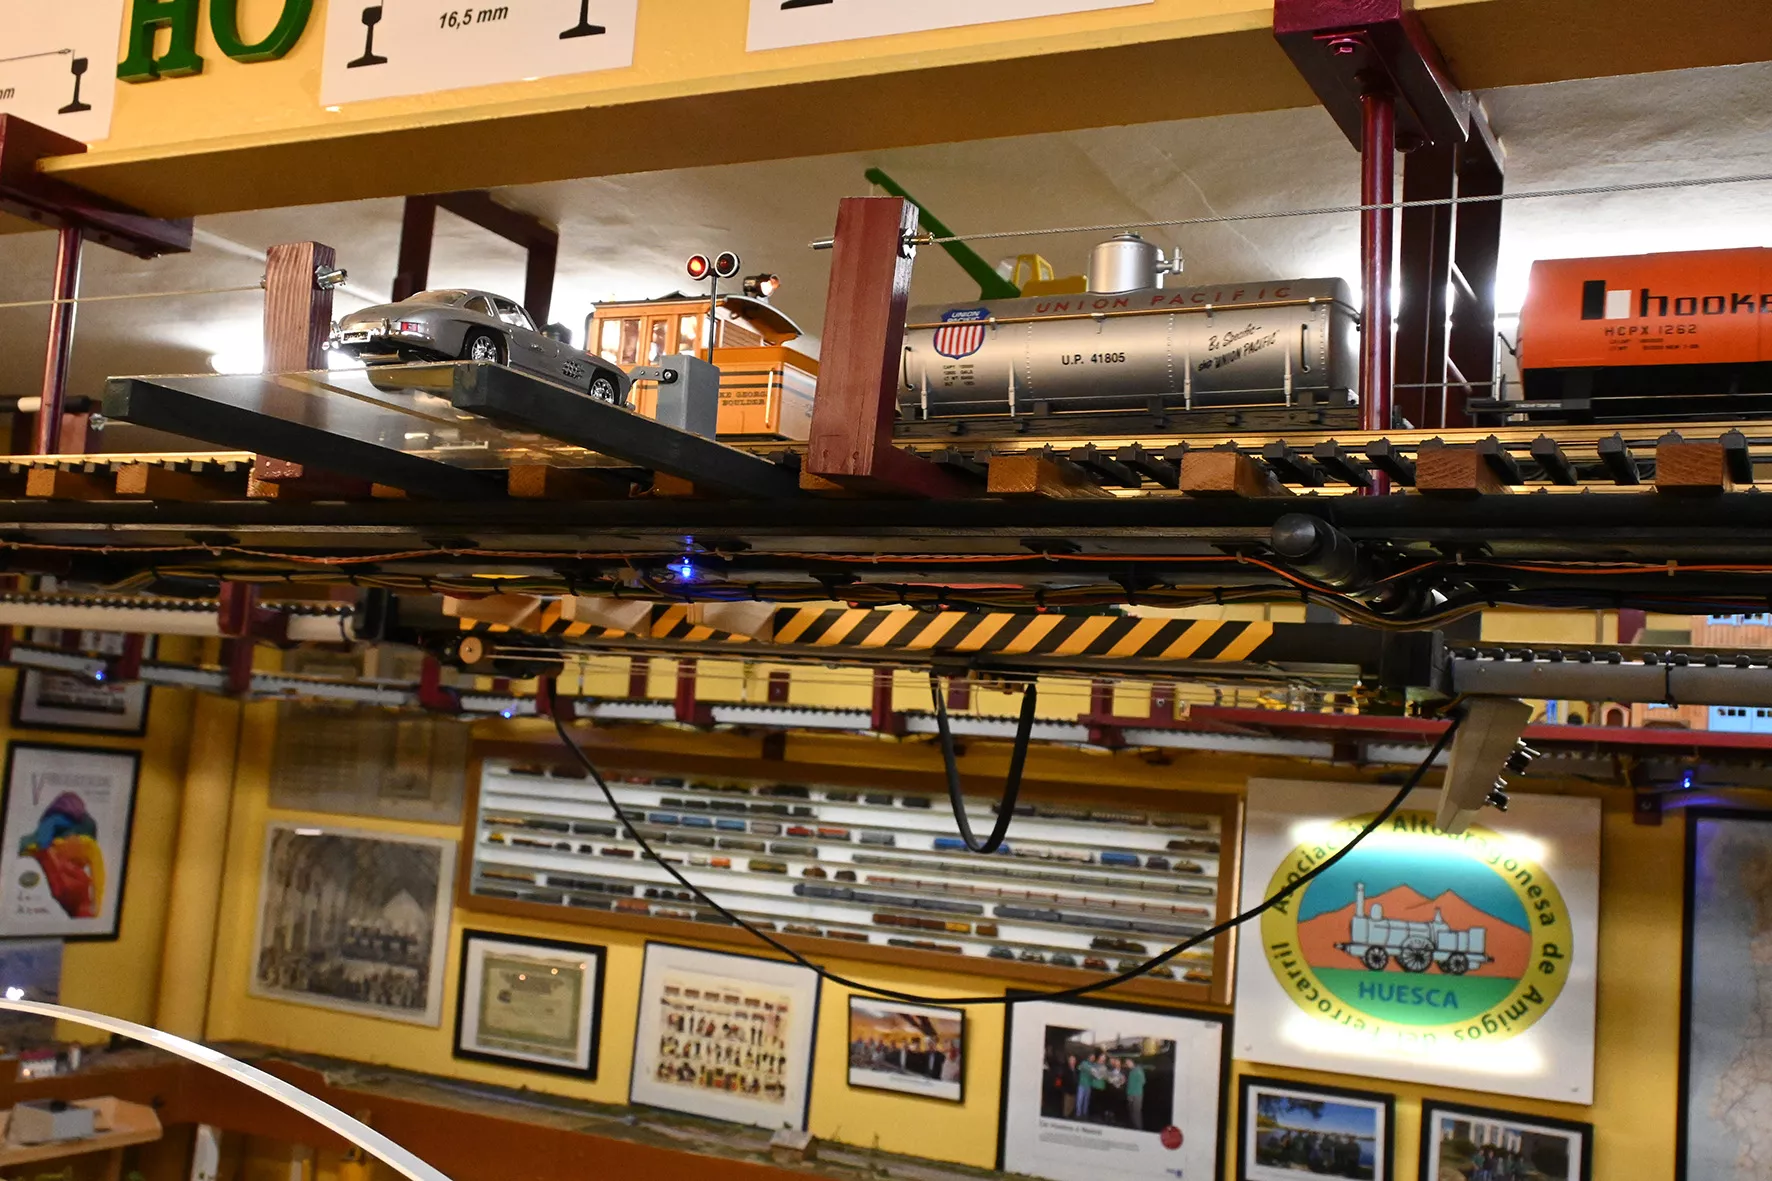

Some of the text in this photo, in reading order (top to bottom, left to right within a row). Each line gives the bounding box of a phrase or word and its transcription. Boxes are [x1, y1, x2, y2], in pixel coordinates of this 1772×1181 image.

[439, 6, 508, 29] 16,5 mm
[1036, 287, 1292, 313] UNION PACIFIC
[951, 310, 981, 318] UNION
[1604, 323, 1697, 337] HCPX 1262
[1062, 351, 1126, 366] U.P. 41805
[1538, 941, 1565, 976] de
[1358, 981, 1460, 1010] HUESCA
[1453, 984, 1545, 1041] Amigos
